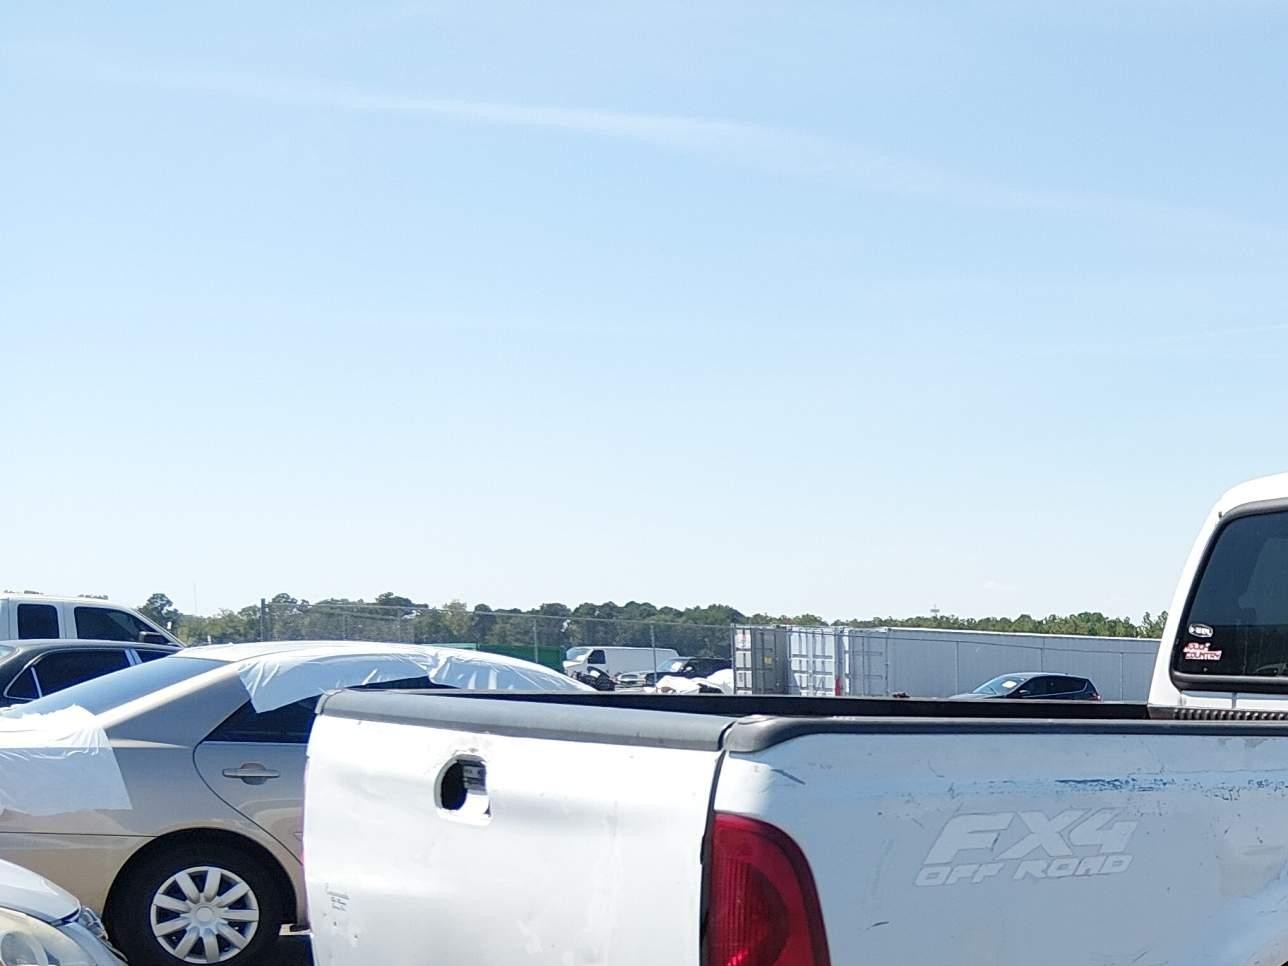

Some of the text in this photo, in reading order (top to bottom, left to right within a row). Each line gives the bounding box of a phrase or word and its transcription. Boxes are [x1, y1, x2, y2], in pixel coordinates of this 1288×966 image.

[923, 808, 1138, 864] FX4
[913, 854, 1134, 887] OFF ROAD
